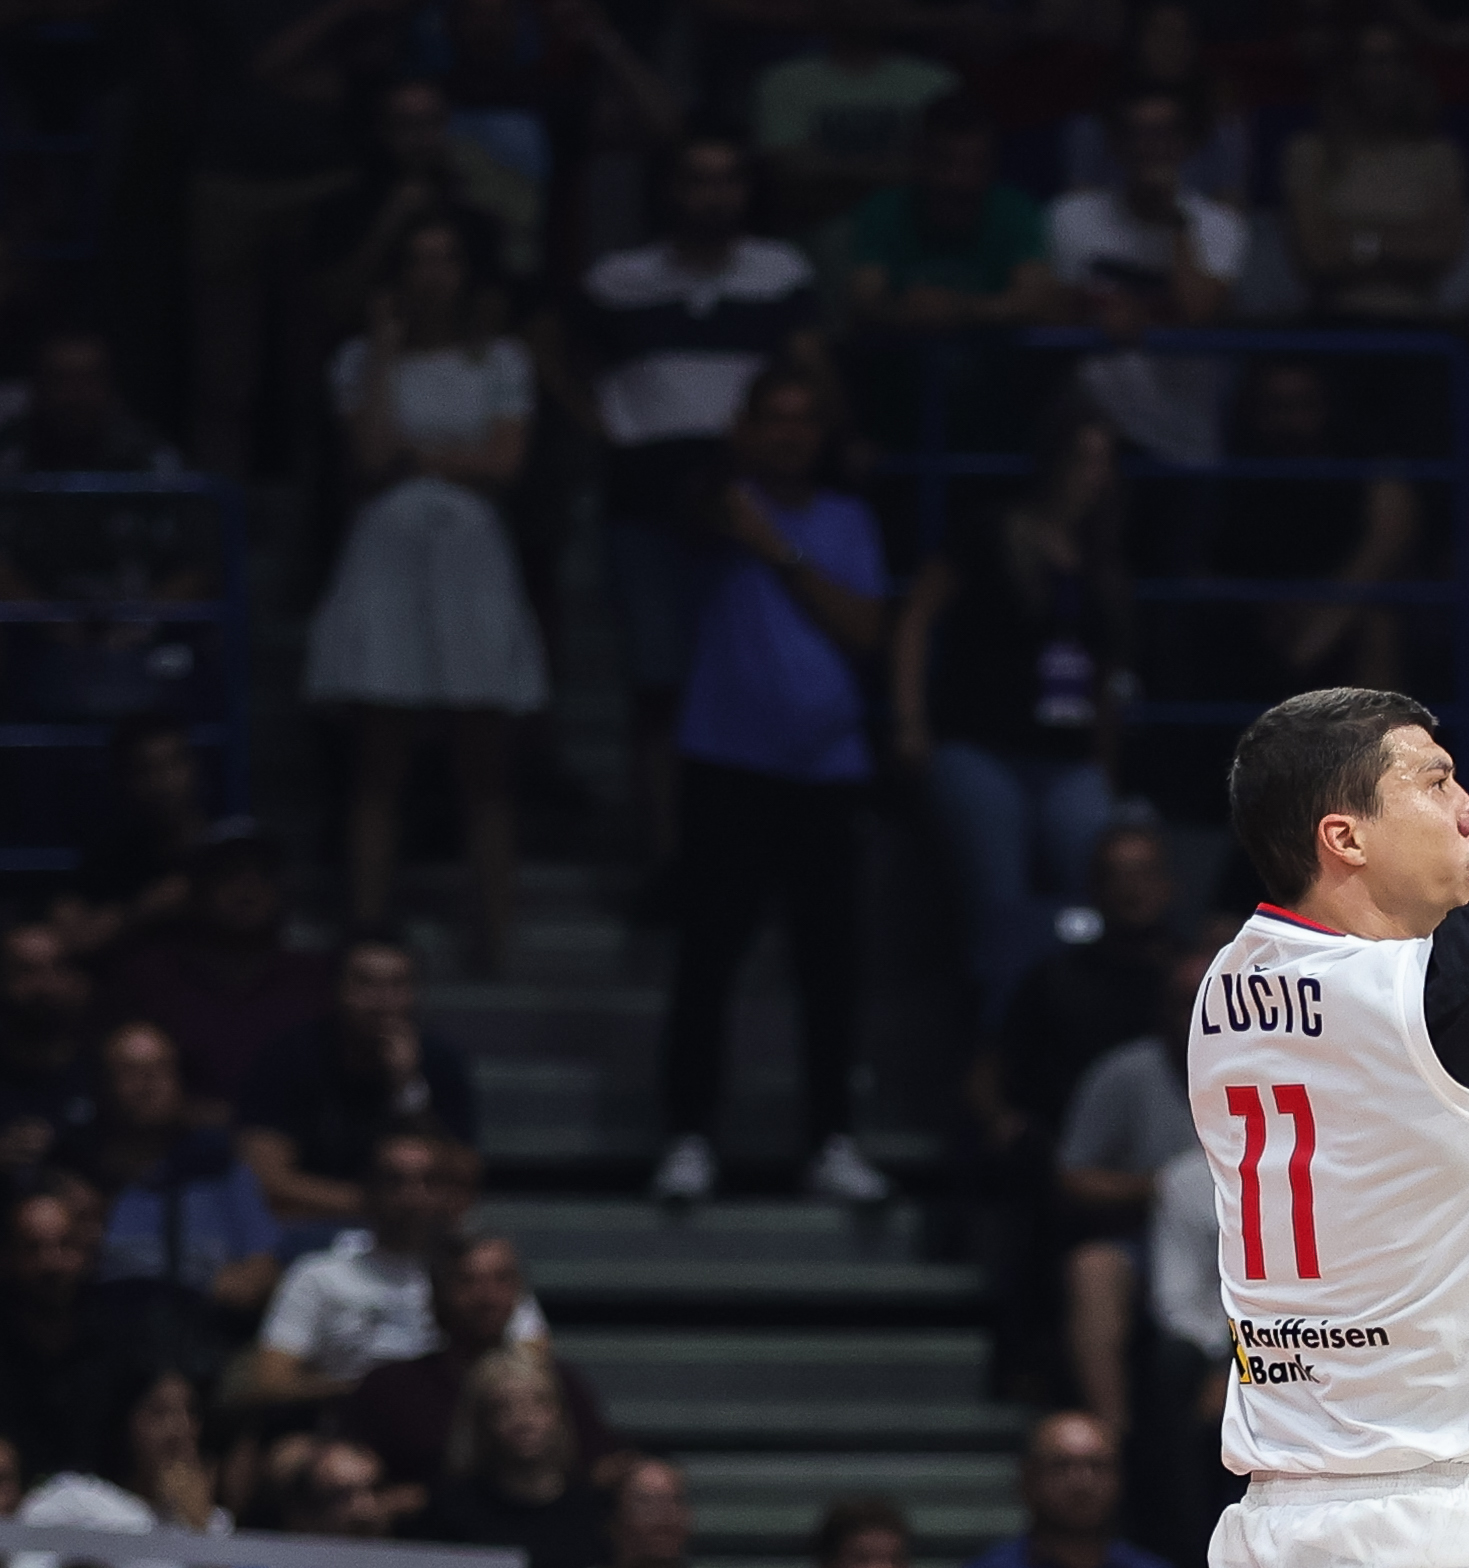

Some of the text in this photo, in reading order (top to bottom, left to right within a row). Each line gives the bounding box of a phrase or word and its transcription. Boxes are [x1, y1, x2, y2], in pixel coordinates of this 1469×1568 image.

[1224, 1083, 1322, 1281] 11
[1240, 1318, 1390, 1349] Raiffeisen
[1248, 1353, 1321, 1385] Bank
